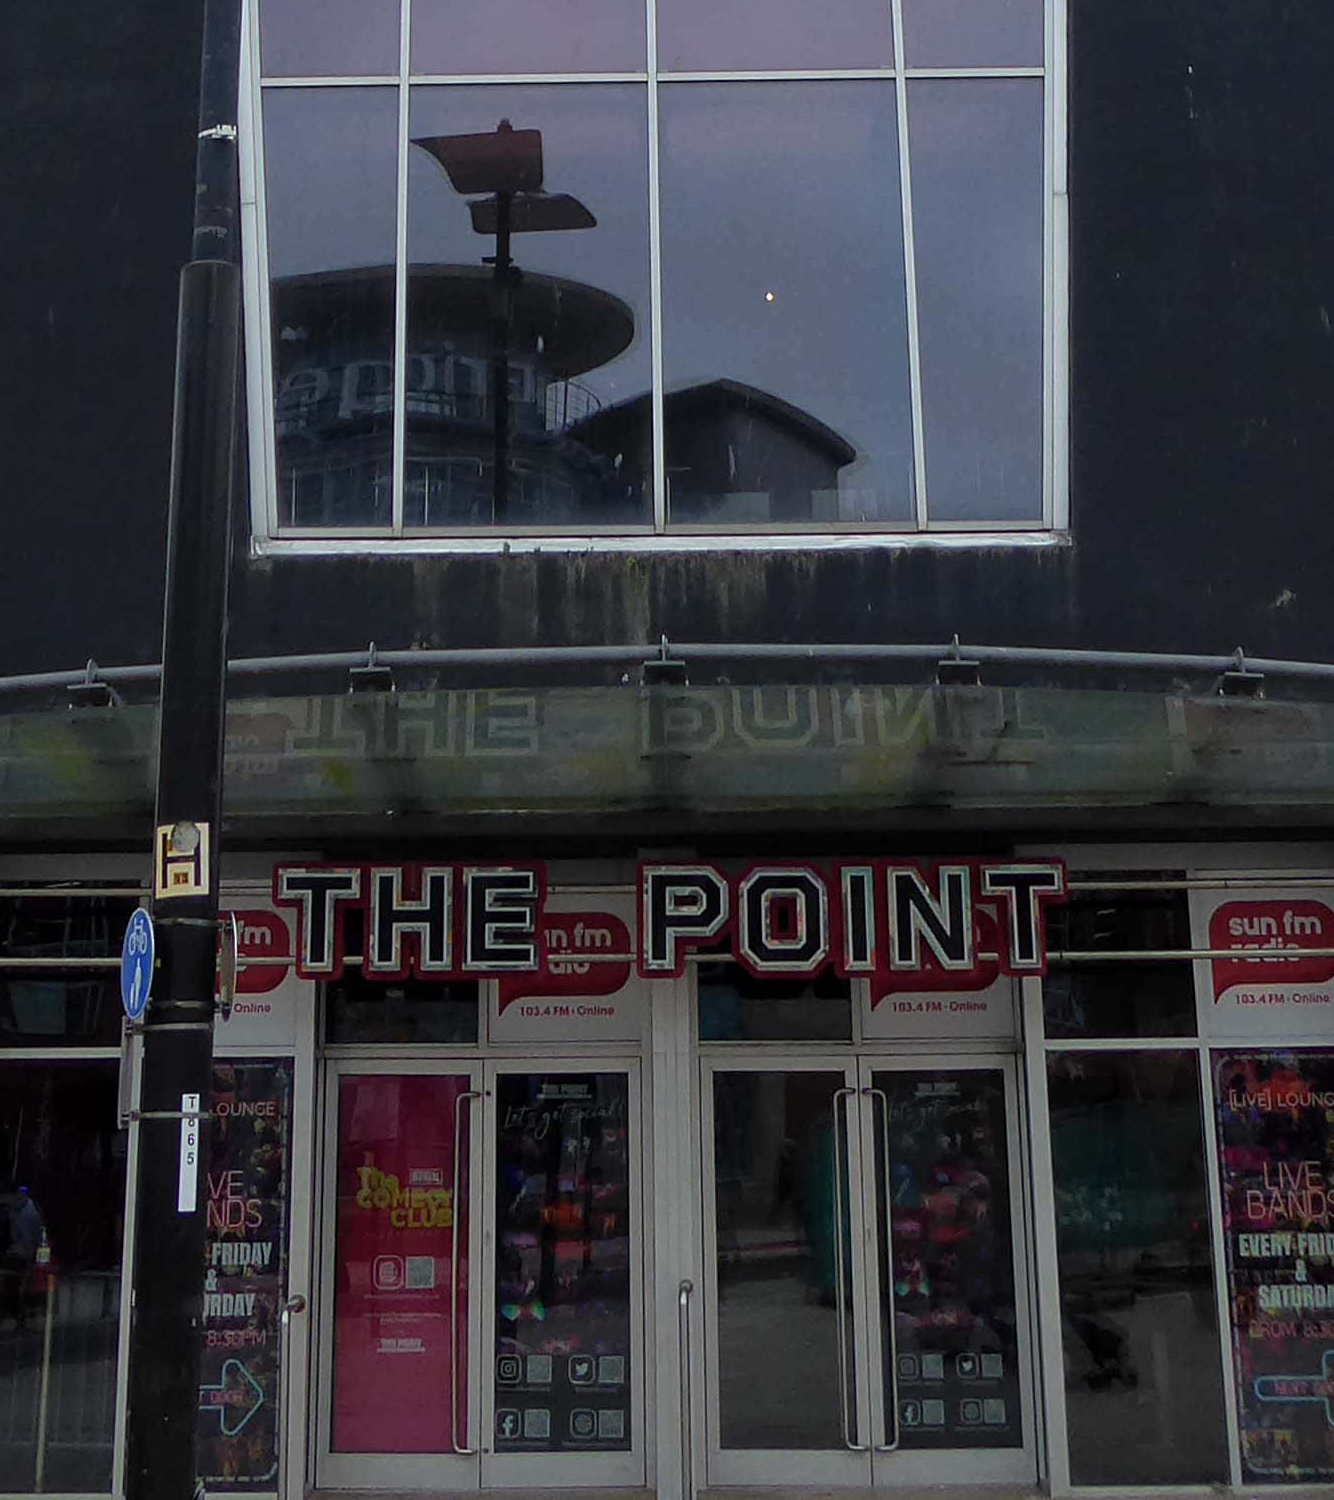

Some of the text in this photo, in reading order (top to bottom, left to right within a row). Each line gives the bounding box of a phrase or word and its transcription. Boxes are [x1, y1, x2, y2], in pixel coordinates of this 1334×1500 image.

[276, 861, 1066, 974] THE POINT
[1228, 909, 1323, 937] sun fm
[519, 1005, 615, 1018] 103.4 FM Online
[925, 1002, 942, 1013] FM
[949, 1001, 988, 1013] Online
[1236, 993, 1331, 1005] 103.4 FM Online
[1262, 1160, 1324, 1190] LIVE
[211, 1242, 273, 1266] FRIDAY
[1238, 1233, 1292, 1258] EVERY
[205, 1267, 218, 1292] &
[1295, 1258, 1308, 1283] &
